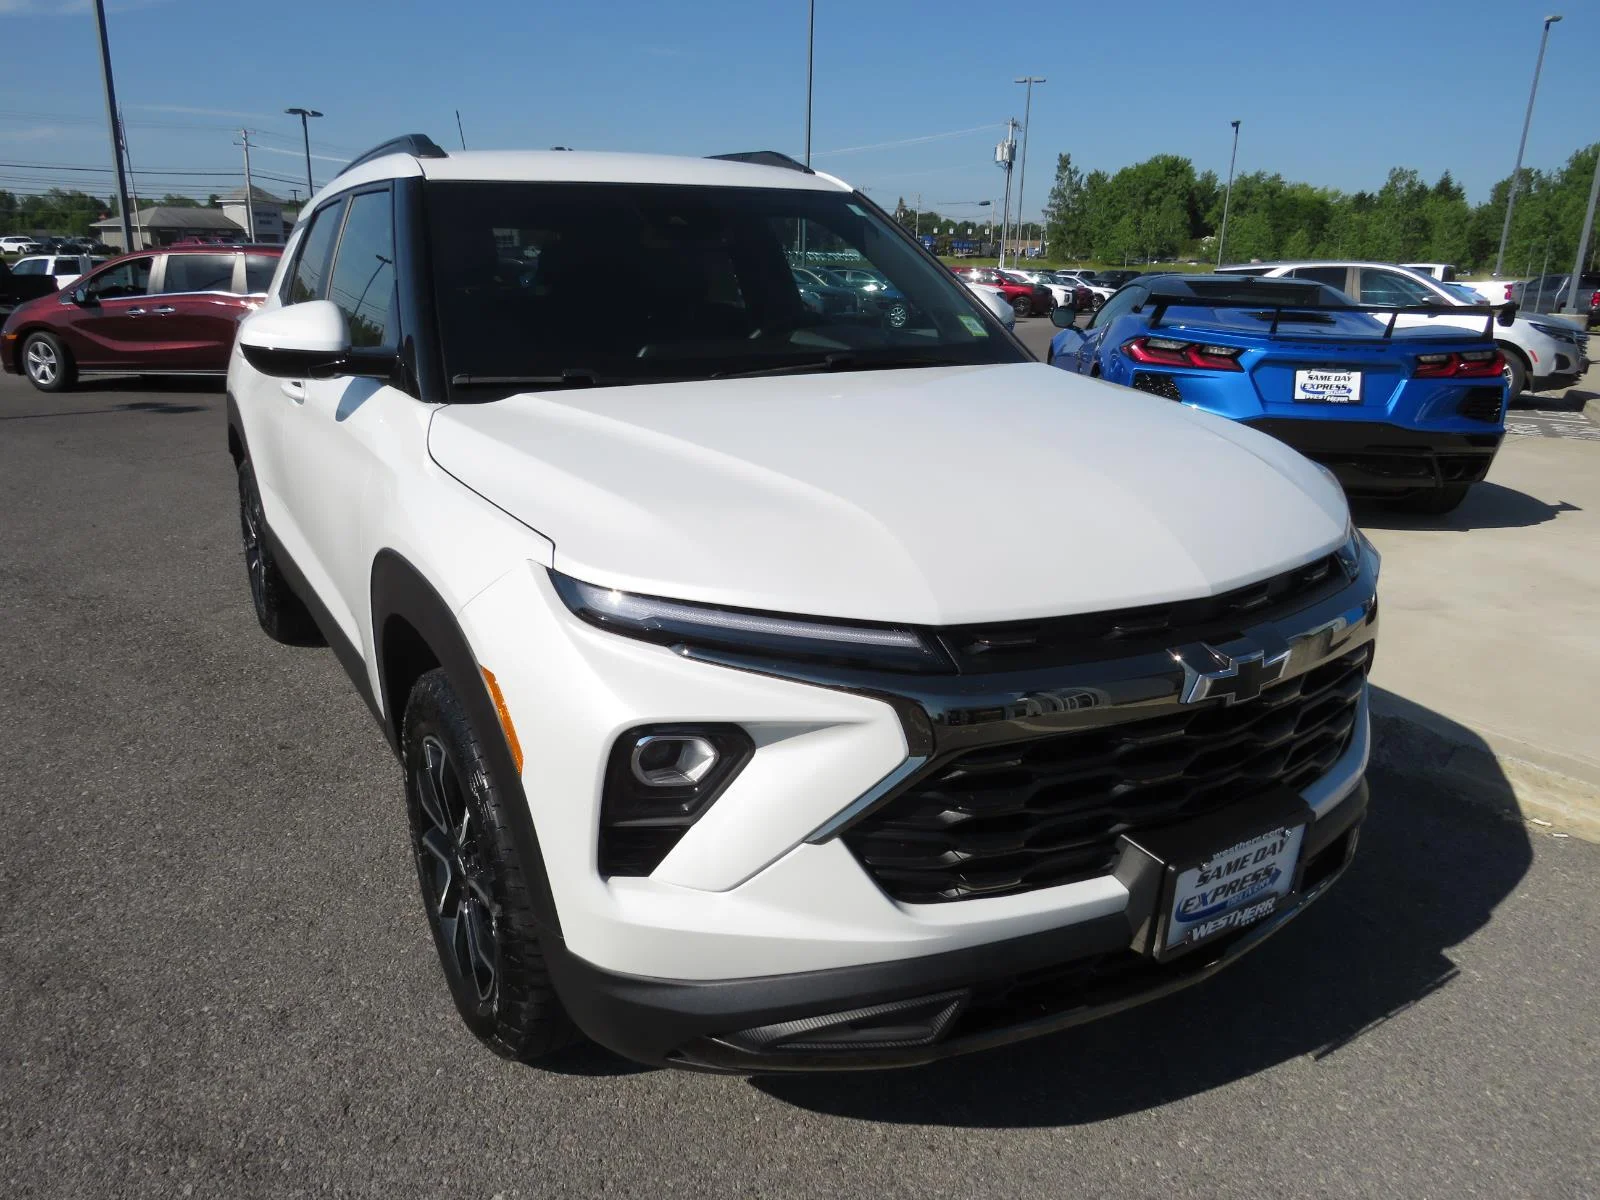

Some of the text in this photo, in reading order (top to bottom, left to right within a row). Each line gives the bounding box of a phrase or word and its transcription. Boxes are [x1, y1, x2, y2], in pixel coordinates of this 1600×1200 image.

[1302, 383, 1347, 391] EXPRESS
[1307, 374, 1332, 382] SAME
[1195, 836, 1290, 889] SAME DAY
[1181, 862, 1276, 914] EXPRESS
